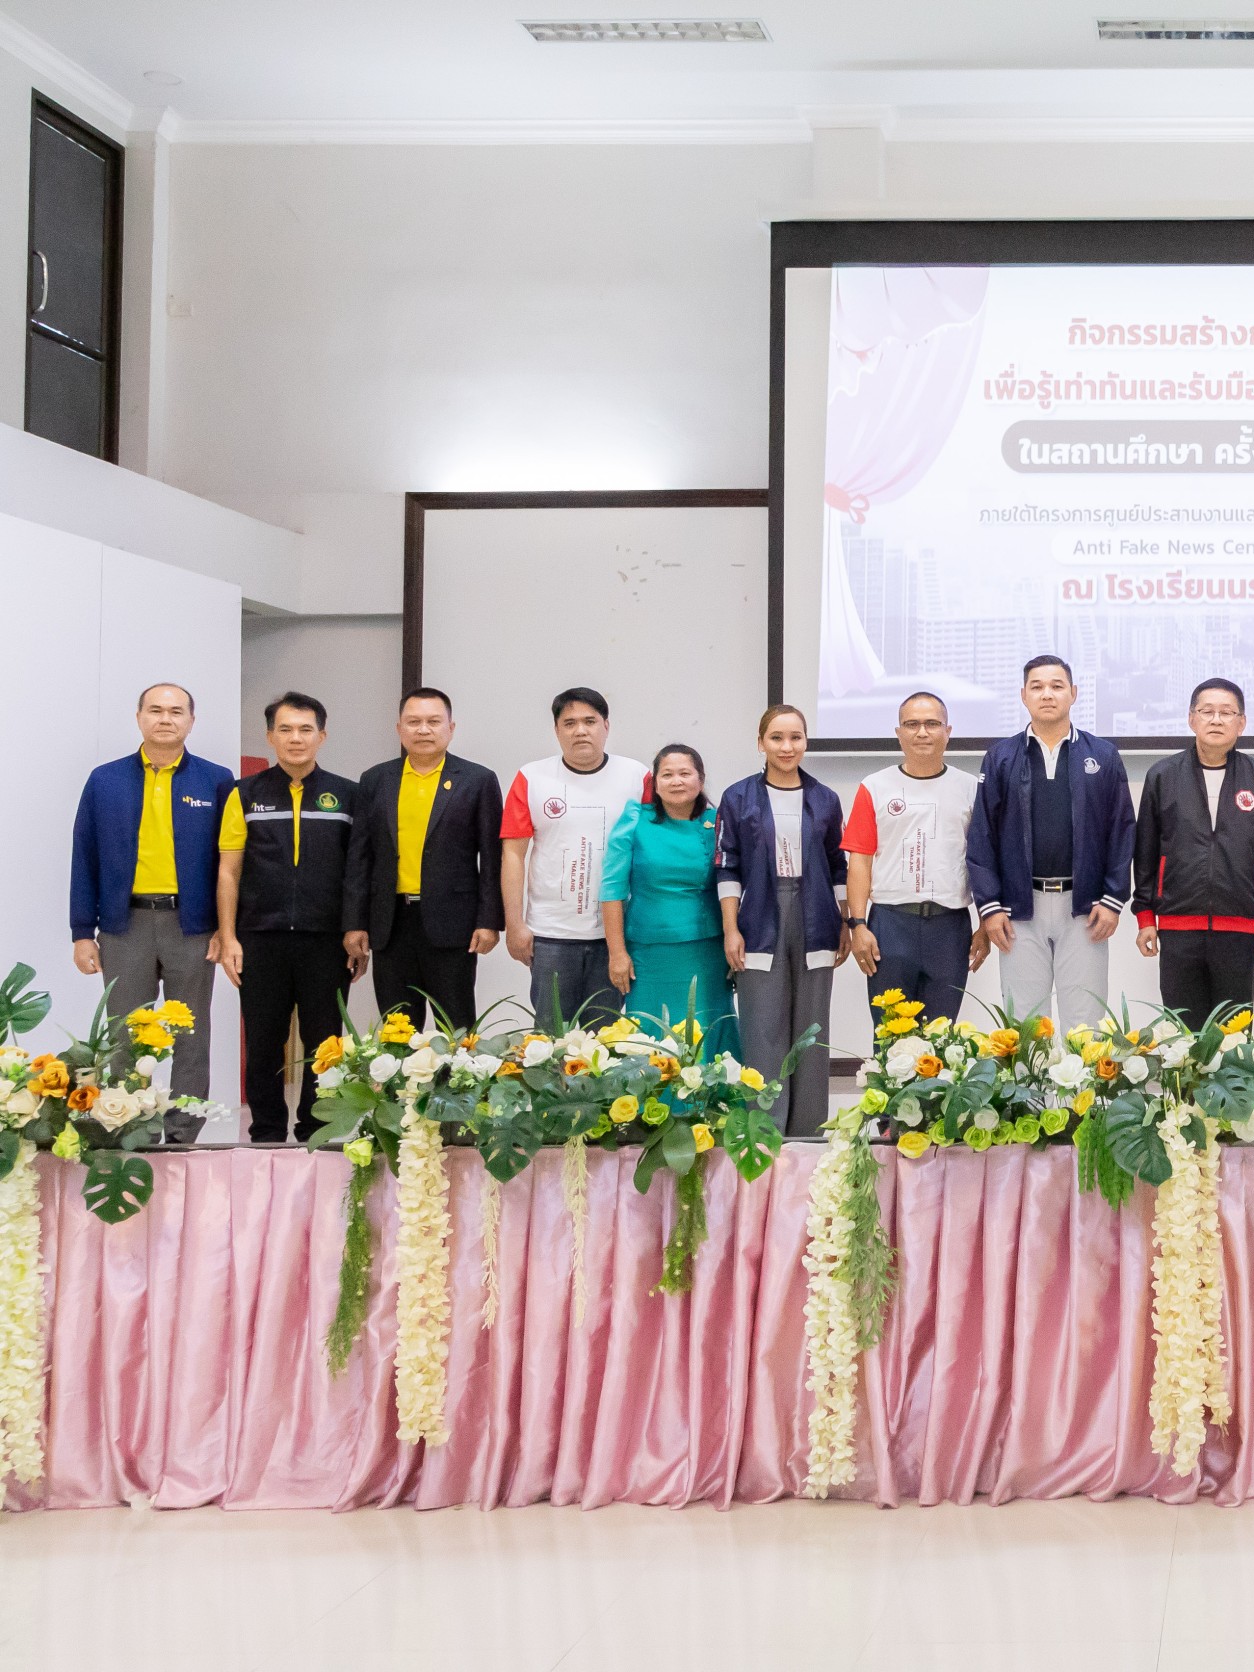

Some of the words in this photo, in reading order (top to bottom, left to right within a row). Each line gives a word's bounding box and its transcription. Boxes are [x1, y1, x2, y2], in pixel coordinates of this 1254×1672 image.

[1018, 434, 1203, 464] ในสถานศึกษา
[1073, 539, 1112, 556] Anti
[1120, 539, 1159, 556] Fake
[1168, 539, 1215, 556] News
[1062, 577, 1093, 600] ณ
